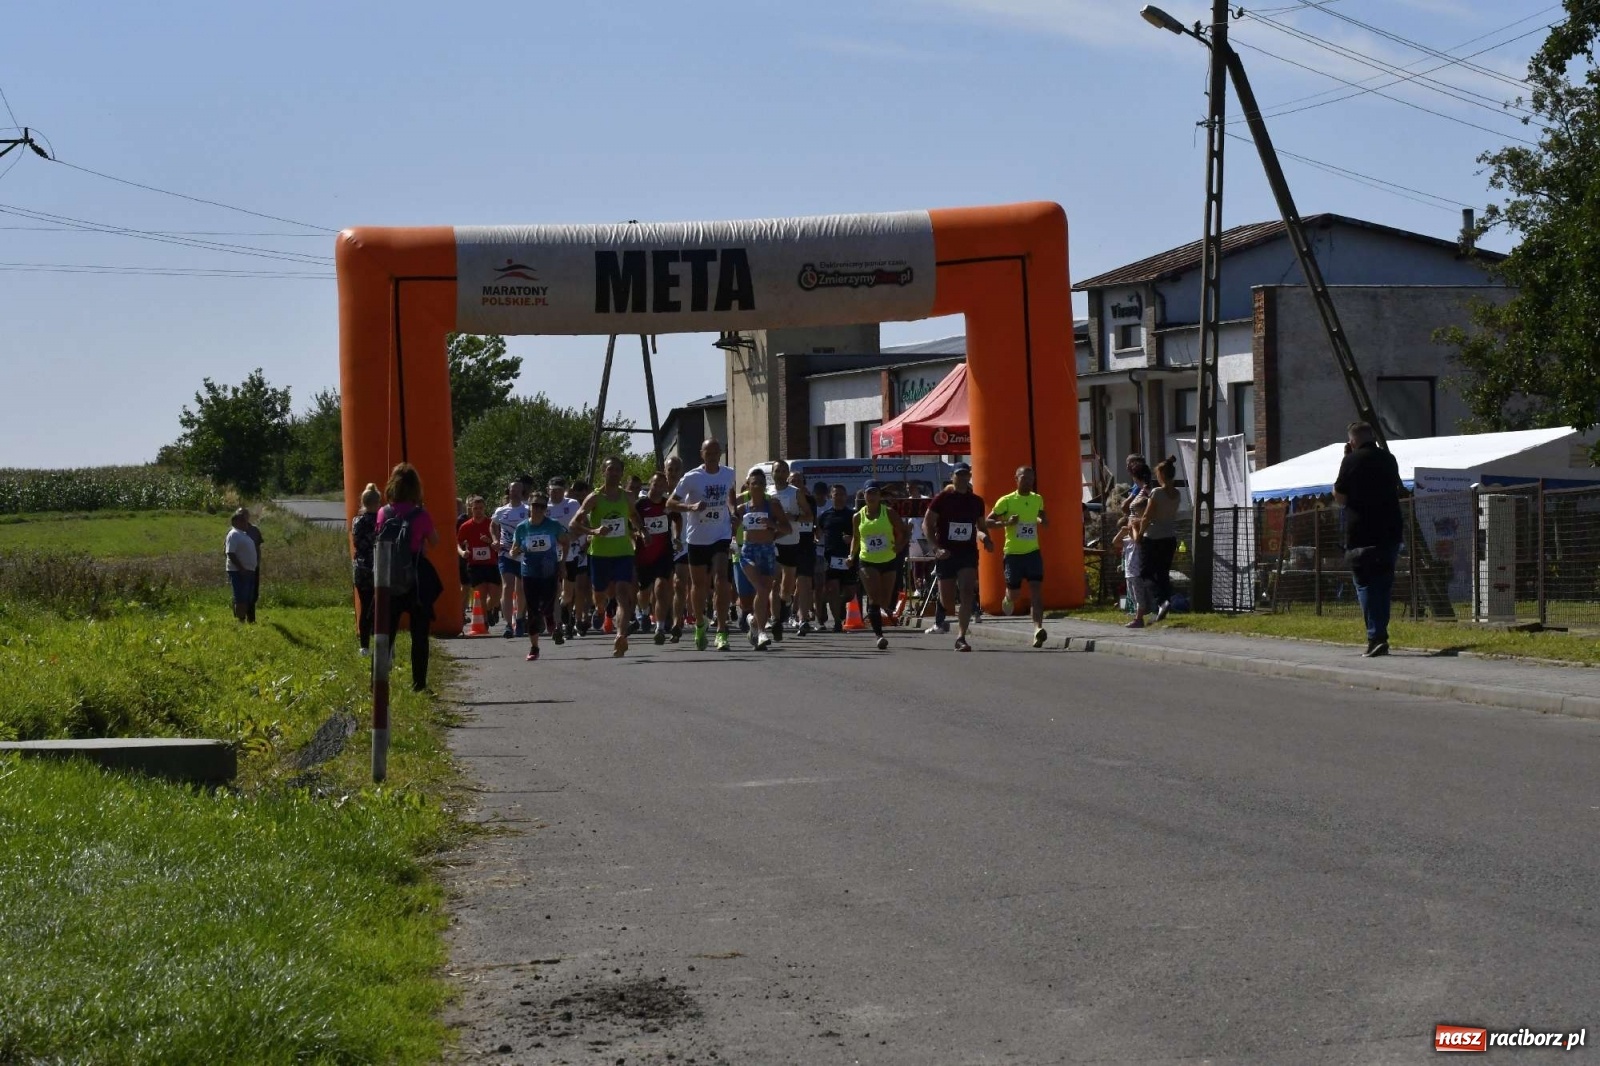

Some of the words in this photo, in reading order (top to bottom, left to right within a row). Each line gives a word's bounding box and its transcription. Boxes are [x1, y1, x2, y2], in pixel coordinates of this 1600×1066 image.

[595, 248, 755, 313] META
[482, 286, 549, 296] MARATONY
[482, 297, 549, 306] POLSKIE.PL
[705, 511, 719, 519] 48
[650, 520, 663, 529] 42
[954, 527, 967, 535] 44
[1021, 526, 1034, 534] 56
[532, 539, 546, 547] 28
[869, 539, 882, 547] 43
